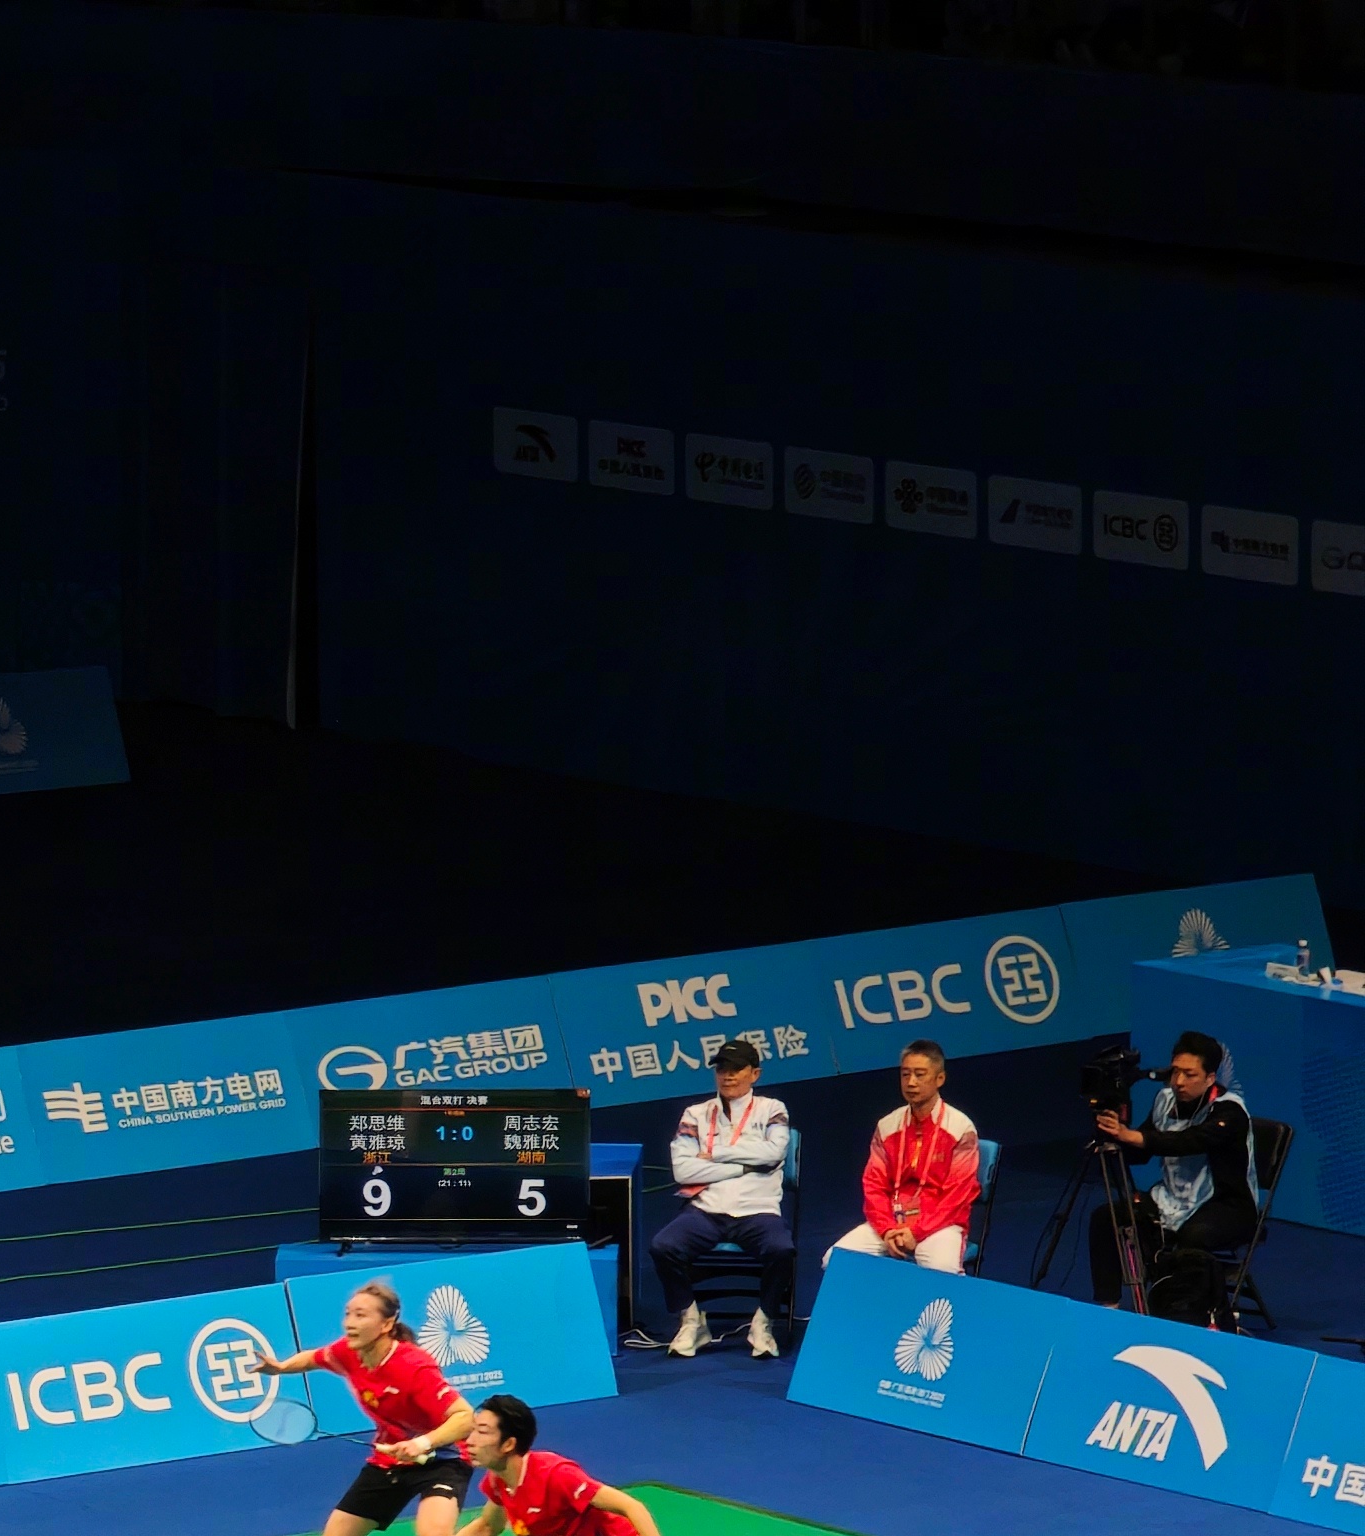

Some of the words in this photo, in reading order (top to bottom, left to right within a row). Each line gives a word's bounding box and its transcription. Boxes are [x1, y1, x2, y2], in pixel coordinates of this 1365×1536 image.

[1104, 514, 1148, 540] ICBC
[637, 974, 737, 1027] PICC
[834, 963, 971, 1029] ICBC
[394, 1025, 544, 1070] 广汽集团
[395, 1068, 451, 1088] GAC
[455, 1051, 548, 1081] GROUP
[112, 1069, 283, 1115] 中国南方电网
[118, 1116, 152, 1129] CHINA
[155, 1109, 214, 1125] SOUTHERN
[217, 1103, 256, 1118] POWER
[259, 1098, 286, 1112] GRID
[349, 1115, 406, 1132] 郑思维
[503, 1115, 559, 1131] 周志宏
[349, 1134, 406, 1150] 黄雅琼
[435, 1126, 473, 1141] 1:0
[503, 1134, 560, 1150] 魏雅欣
[363, 1151, 392, 1164] 浙江
[516, 1151, 546, 1164] 湖南
[362, 1178, 392, 1217] 9
[517, 1178, 547, 1217] 5
[7, 1352, 172, 1431] ICBC
[1087, 1401, 1178, 1461] ANTA
